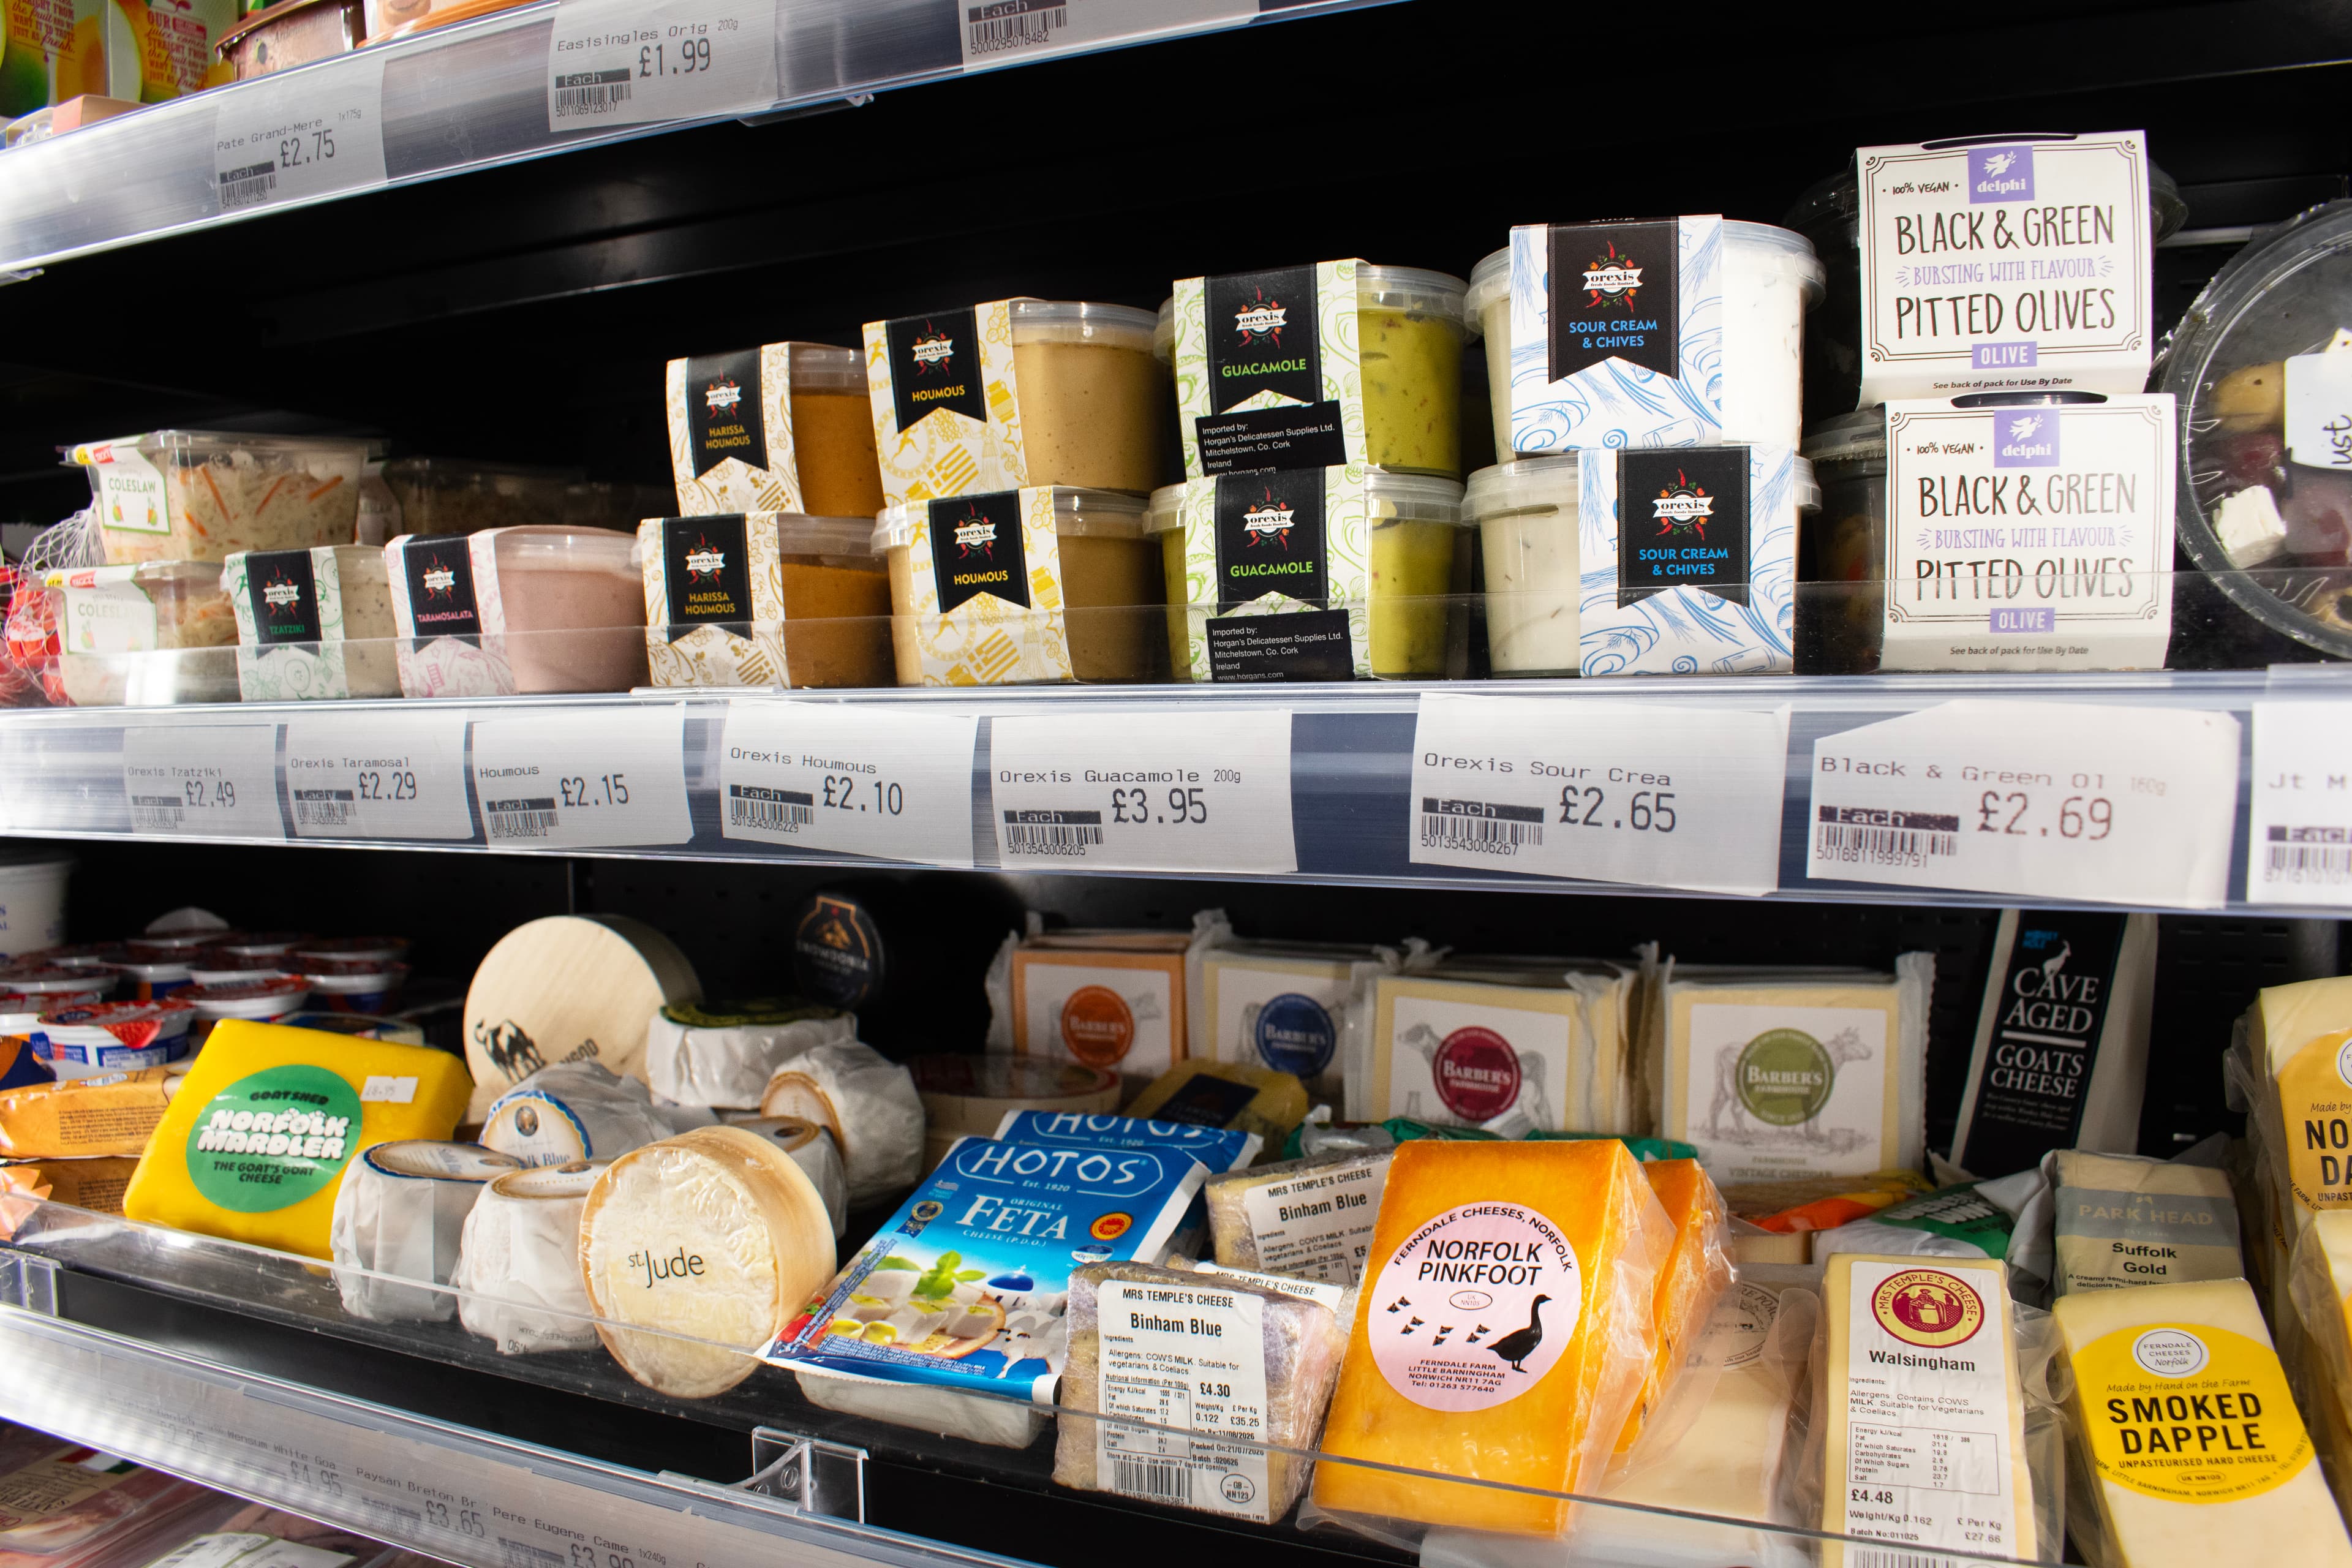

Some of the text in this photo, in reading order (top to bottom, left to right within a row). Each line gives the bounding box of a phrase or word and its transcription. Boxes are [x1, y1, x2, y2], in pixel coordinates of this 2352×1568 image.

[558, 24, 707, 51] Easisingles Orig
[639, 38, 710, 77] £1.99
[565, 72, 601, 86] Each
[217, 119, 323, 151] Pate Grand-Mere
[281, 129, 334, 168] £2.75
[1893, 182, 1950, 195] 100% VEGAN
[1977, 179, 2026, 195] delphi
[1895, 205, 2114, 254] BLACK & GREEN
[1591, 272, 1634, 282] orexis
[1914, 257, 2096, 285] BURSTING WITH FLAVOUR
[1896, 288, 2115, 339] PITTED OLIVES
[1981, 346, 2028, 364] OLIVE
[1222, 359, 1306, 377] GUACAMOLE
[1984, 380, 2004, 389] pack
[912, 385, 965, 401] HOUMOUS
[709, 425, 745, 436] HARISSA
[706, 435, 750, 449] HOUMOUS
[109, 478, 156, 493] COLESLAW
[1661, 500, 1705, 510] orexis
[1251, 514, 1287, 524] orexis
[1639, 548, 1728, 560] SOUR CREAM
[954, 570, 1008, 585] HOUMOUS
[1231, 562, 1313, 578] GUACAMOLE
[1653, 564, 1715, 575] & CHIVES
[417, 610, 473, 623] TARAMOSALATA
[269, 625, 305, 635] TZATZIKI
[1214, 638, 1245, 648] Horgan's
[1246, 636, 1293, 646] Delicatessen
[1294, 633, 1327, 644] Supplies
[1215, 650, 1264, 659] Mitchelstown,
[1218, 671, 1284, 682] www.horgans.com
[291, 757, 409, 769] Orexis Taramosal
[731, 747, 876, 774] Orexis Houmous
[128, 767, 222, 777] Orexis Tzatziki
[480, 766, 540, 778] Houmous
[1000, 769, 1241, 783] Orexis Guacamole 200g
[1424, 753, 1671, 786] Orexis Sour Crea
[1822, 757, 1907, 777] Black
[1926, 765, 1942, 780] &
[1962, 767, 2052, 787] Green
[186, 781, 235, 807] £2.49
[359, 772, 417, 800] £2.29
[560, 774, 628, 807] £2.15
[823, 775, 902, 815] £2.10
[1112, 788, 1207, 823] £3.95
[1559, 785, 1676, 832] £2.65
[1977, 791, 2112, 840] £2.69
[1009, 843, 1085, 856] 5013543006205
[2013, 968, 2099, 1004] CAVE
[2003, 998, 2093, 1033] AGED
[1996, 1044, 2085, 1077] GOATS
[1991, 1068, 2078, 1098] CHEESE
[209, 1108, 350, 1137] NORFOLK
[198, 1129, 345, 1160] MARDLER
[214, 1161, 314, 1177] THE GOAT'S GOAT
[971, 1145, 1140, 1185] HOTOS
[239, 1174, 282, 1185] CHEESE
[1022, 1180, 1071, 1192] Est. 1920
[1268, 1169, 1372, 1197] MRS TEMPLE'S CHEESE
[1010, 1198, 1063, 1211] ORIGINAL
[1280, 1193, 1367, 1221] Binham Blue
[956, 1194, 1069, 1239] FETA
[2079, 1204, 2214, 1226] PARK HEAD
[963, 1229, 1003, 1241] CHEESE
[1394, 1207, 1572, 1273] FERNDALE CHEESES, NORFOLK
[1427, 1240, 1544, 1262] NORFOLK
[2112, 1242, 2177, 1259] Suffolk
[645, 1246, 704, 1288] Jude
[1419, 1262, 1542, 1286] PINKFOOT
[2124, 1262, 2167, 1276] Gold
[1123, 1288, 1234, 1308] MRS TEMPLE'S CHEESE
[1131, 1313, 1222, 1337] Binham Blue
[1104, 1334, 1133, 1343] Ingredients
[1109, 1360, 1148, 1370] vegetarians
[1199, 1359, 1226, 1370] Suitable
[1420, 1359, 1468, 1368] FERNDALE
[1869, 1350, 1975, 1372] Walsingham
[2154, 1357, 2189, 1368] Norfolk
[1409, 1373, 1453, 1382] NORWICH
[1455, 1376, 1479, 1384] NR11
[1440, 1368, 1505, 1379] BARNINGHAM
[1200, 1382, 1230, 1398] £4.30
[1460, 1384, 1494, 1393] 577640
[2106, 1382, 2135, 1392] Made
[2139, 1383, 2151, 1393] by
[2154, 1381, 2184, 1390] Hand
[2201, 1379, 2219, 1389] the
[2222, 1378, 2251, 1387] Farm
[1897, 1393, 1934, 1403] Contains
[1931, 1405, 1984, 1415] Vegetarians
[2106, 1392, 2263, 1424] SMOKED
[1196, 1413, 1259, 1427] 0.122 £35.25
[2119, 1423, 2266, 1455] DAPPLE
[227, 1429, 336, 1470] Wensum White Goa
[2118, 1454, 2277, 1469] UNPASTEURISED HARD CHEESE
[356, 1466, 477, 1507] Paysan Breton Br
[1850, 1488, 1893, 1504] £4.48
[425, 1499, 485, 1540] £3.65
[494, 1506, 526, 1526] Pere
[535, 1519, 585, 1542] Eugene
[594, 1535, 630, 1555] Came
